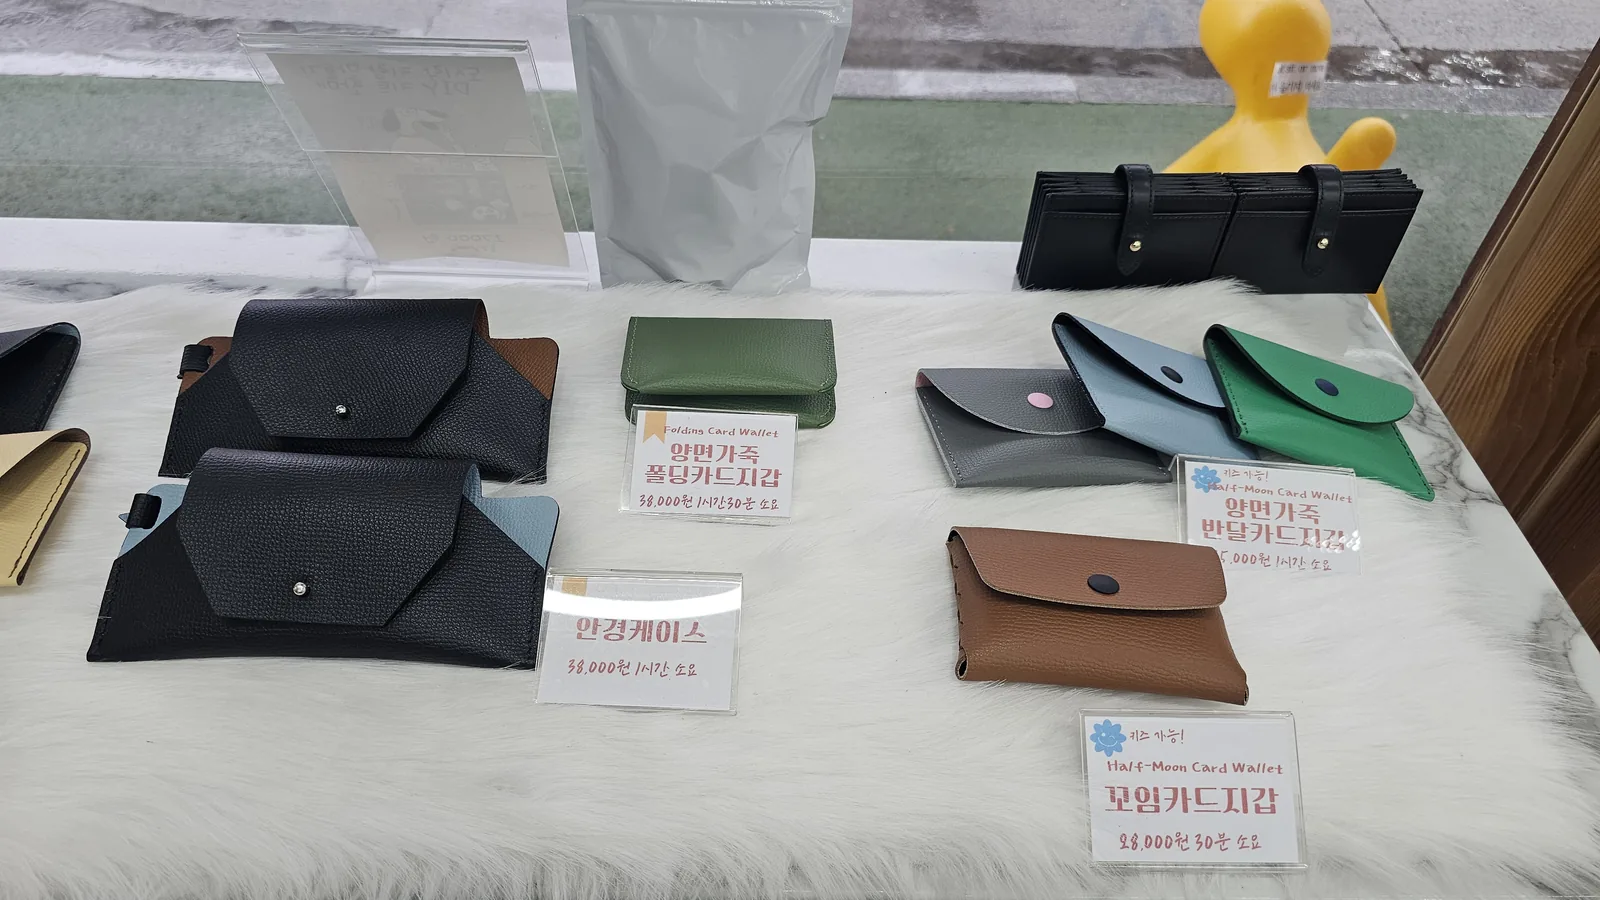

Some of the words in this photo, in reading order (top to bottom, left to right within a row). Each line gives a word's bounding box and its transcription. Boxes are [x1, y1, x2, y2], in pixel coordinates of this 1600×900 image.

[664, 425, 704, 436] Folding
[707, 426, 736, 437] Card
[739, 428, 779, 438] Wallet
[670, 443, 760, 465] 양면가죽
[644, 464, 782, 488] 폴딩카드지갑
[1224, 468, 1241, 478] 키즈
[639, 494, 693, 509] 38,000원
[759, 498, 780, 511] 소요
[1207, 482, 1273, 496] Half-Moon
[1277, 487, 1307, 499] Card
[1311, 490, 1353, 504] Wallet
[1225, 497, 1321, 525] 양면가죽
[1220, 550, 1271, 568] 5,000원
[1310, 558, 1332, 571] 소요
[576, 617, 708, 644] 안경케이스
[567, 658, 631, 677] 38,000원
[675, 663, 698, 677] 소요
[1129, 729, 1150, 742] 키즈
[1154, 728, 1185, 745] 가능!
[1107, 760, 1188, 773] Half-Moon
[1192, 762, 1228, 774] Card
[1232, 763, 1284, 775] Wallet
[1104, 786, 1280, 815] 꼬임카드지갑
[1194, 832, 1232, 851] 30분
[1237, 834, 1263, 851] 소요
